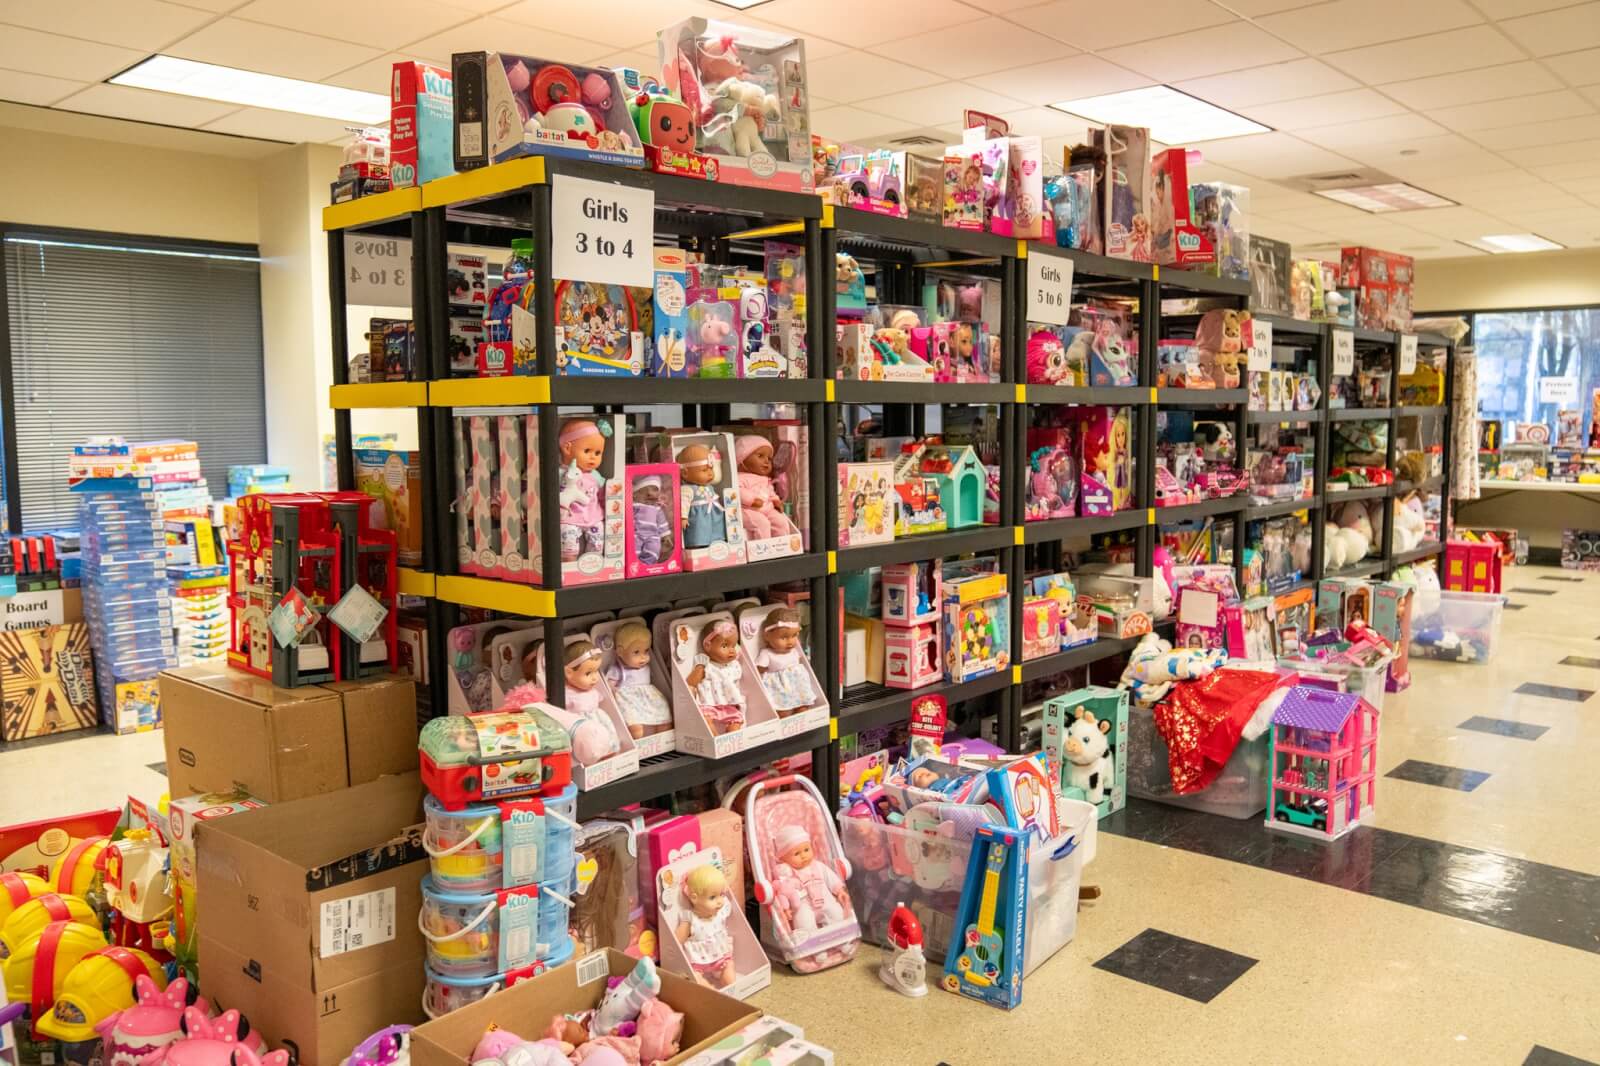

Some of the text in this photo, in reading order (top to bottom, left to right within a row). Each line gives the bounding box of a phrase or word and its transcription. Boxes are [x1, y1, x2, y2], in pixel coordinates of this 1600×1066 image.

[536, 129, 565, 142] battat
[392, 165, 414, 182] KID
[582, 197, 628, 223] Girls
[575, 232, 634, 258] 3 to 4
[1179, 235, 1200, 247] KID
[1041, 265, 1062, 282] Girls
[1037, 289, 1063, 306] 5 to 6
[487, 348, 504, 363] KID
[6, 600, 48, 613] Board
[4, 618, 51, 631] Games
[512, 812, 535, 824] KID
[508, 896, 529, 908] KID
